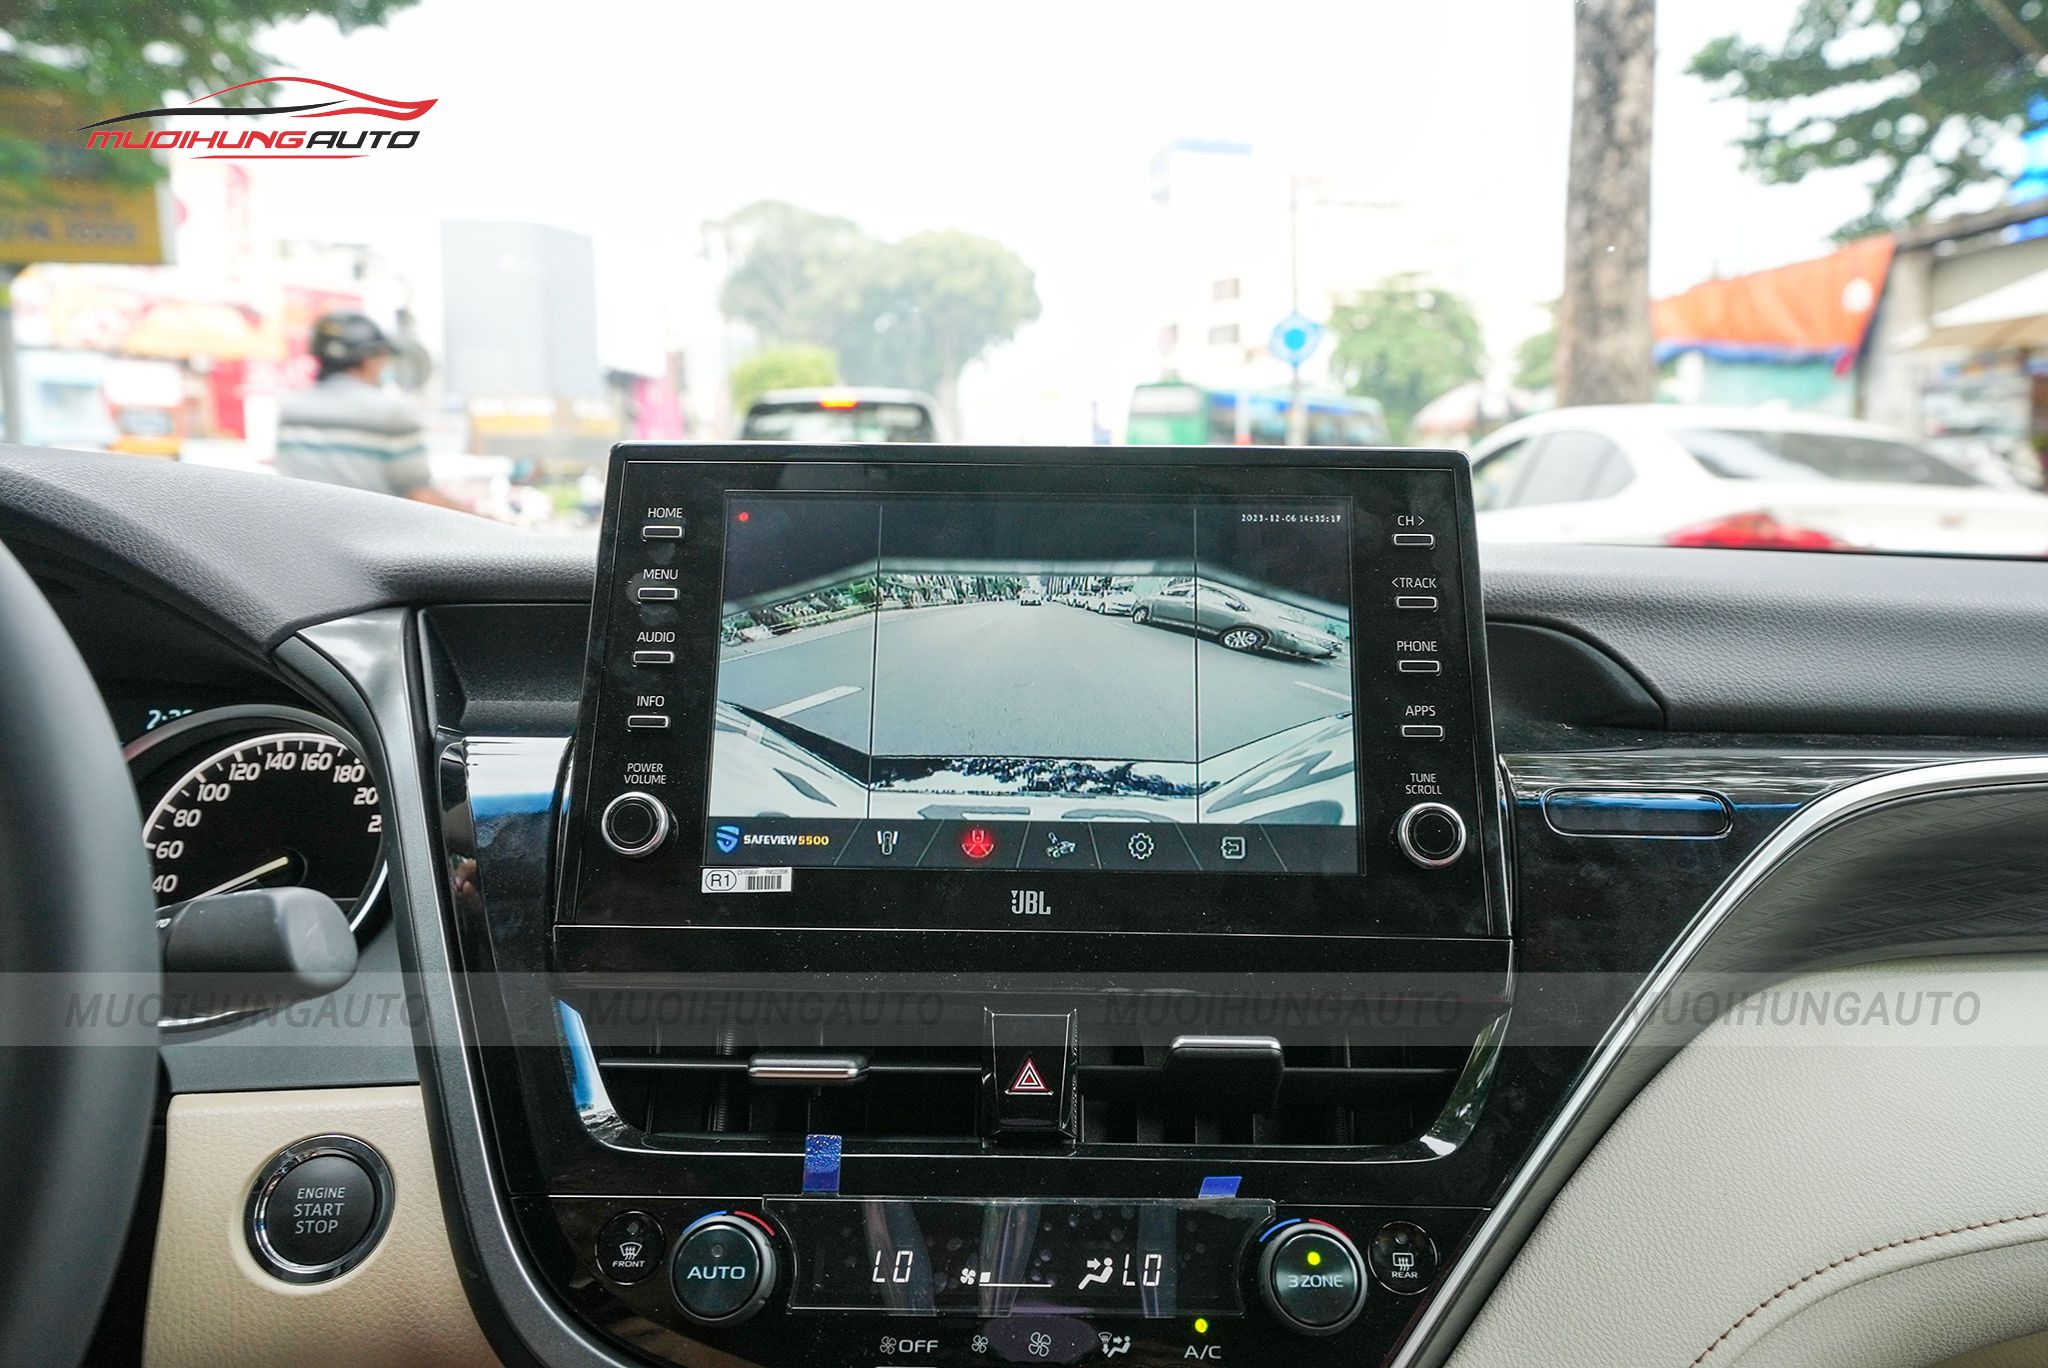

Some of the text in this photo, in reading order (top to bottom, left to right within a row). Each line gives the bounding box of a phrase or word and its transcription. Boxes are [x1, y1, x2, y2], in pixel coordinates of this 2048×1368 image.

[647, 507, 683, 519] HOME
[642, 568, 679, 580] MENU
[636, 632, 676, 643] AUDIO
[1396, 641, 1438, 652] PHONE
[636, 695, 665, 707] INFO
[1405, 705, 1436, 717] APPS
[264, 752, 297, 771] 140
[301, 753, 333, 771] 160
[627, 763, 664, 773] POWER
[228, 763, 261, 781] 120
[332, 765, 365, 783] 180
[1410, 773, 1437, 783] TUNE
[623, 774, 667, 785] VOLUME
[196, 784, 230, 802] 100
[1405, 784, 1442, 795] SCROLL
[173, 809, 201, 827] 80
[155, 840, 184, 859] 60
[152, 874, 178, 893] 40
[710, 873, 730, 887] R1
[1011, 890, 1051, 914] JBL
[297, 1187, 346, 1199] ENGINE
[293, 1202, 345, 1217] START
[295, 1220, 339, 1234] STOP
[612, 1260, 645, 1268] FRONT
[687, 1265, 746, 1280] AUTO
[1391, 1271, 1418, 1279] REAR
[898, 1340, 939, 1353] OFF
[1184, 1345, 1222, 1361] A/C
